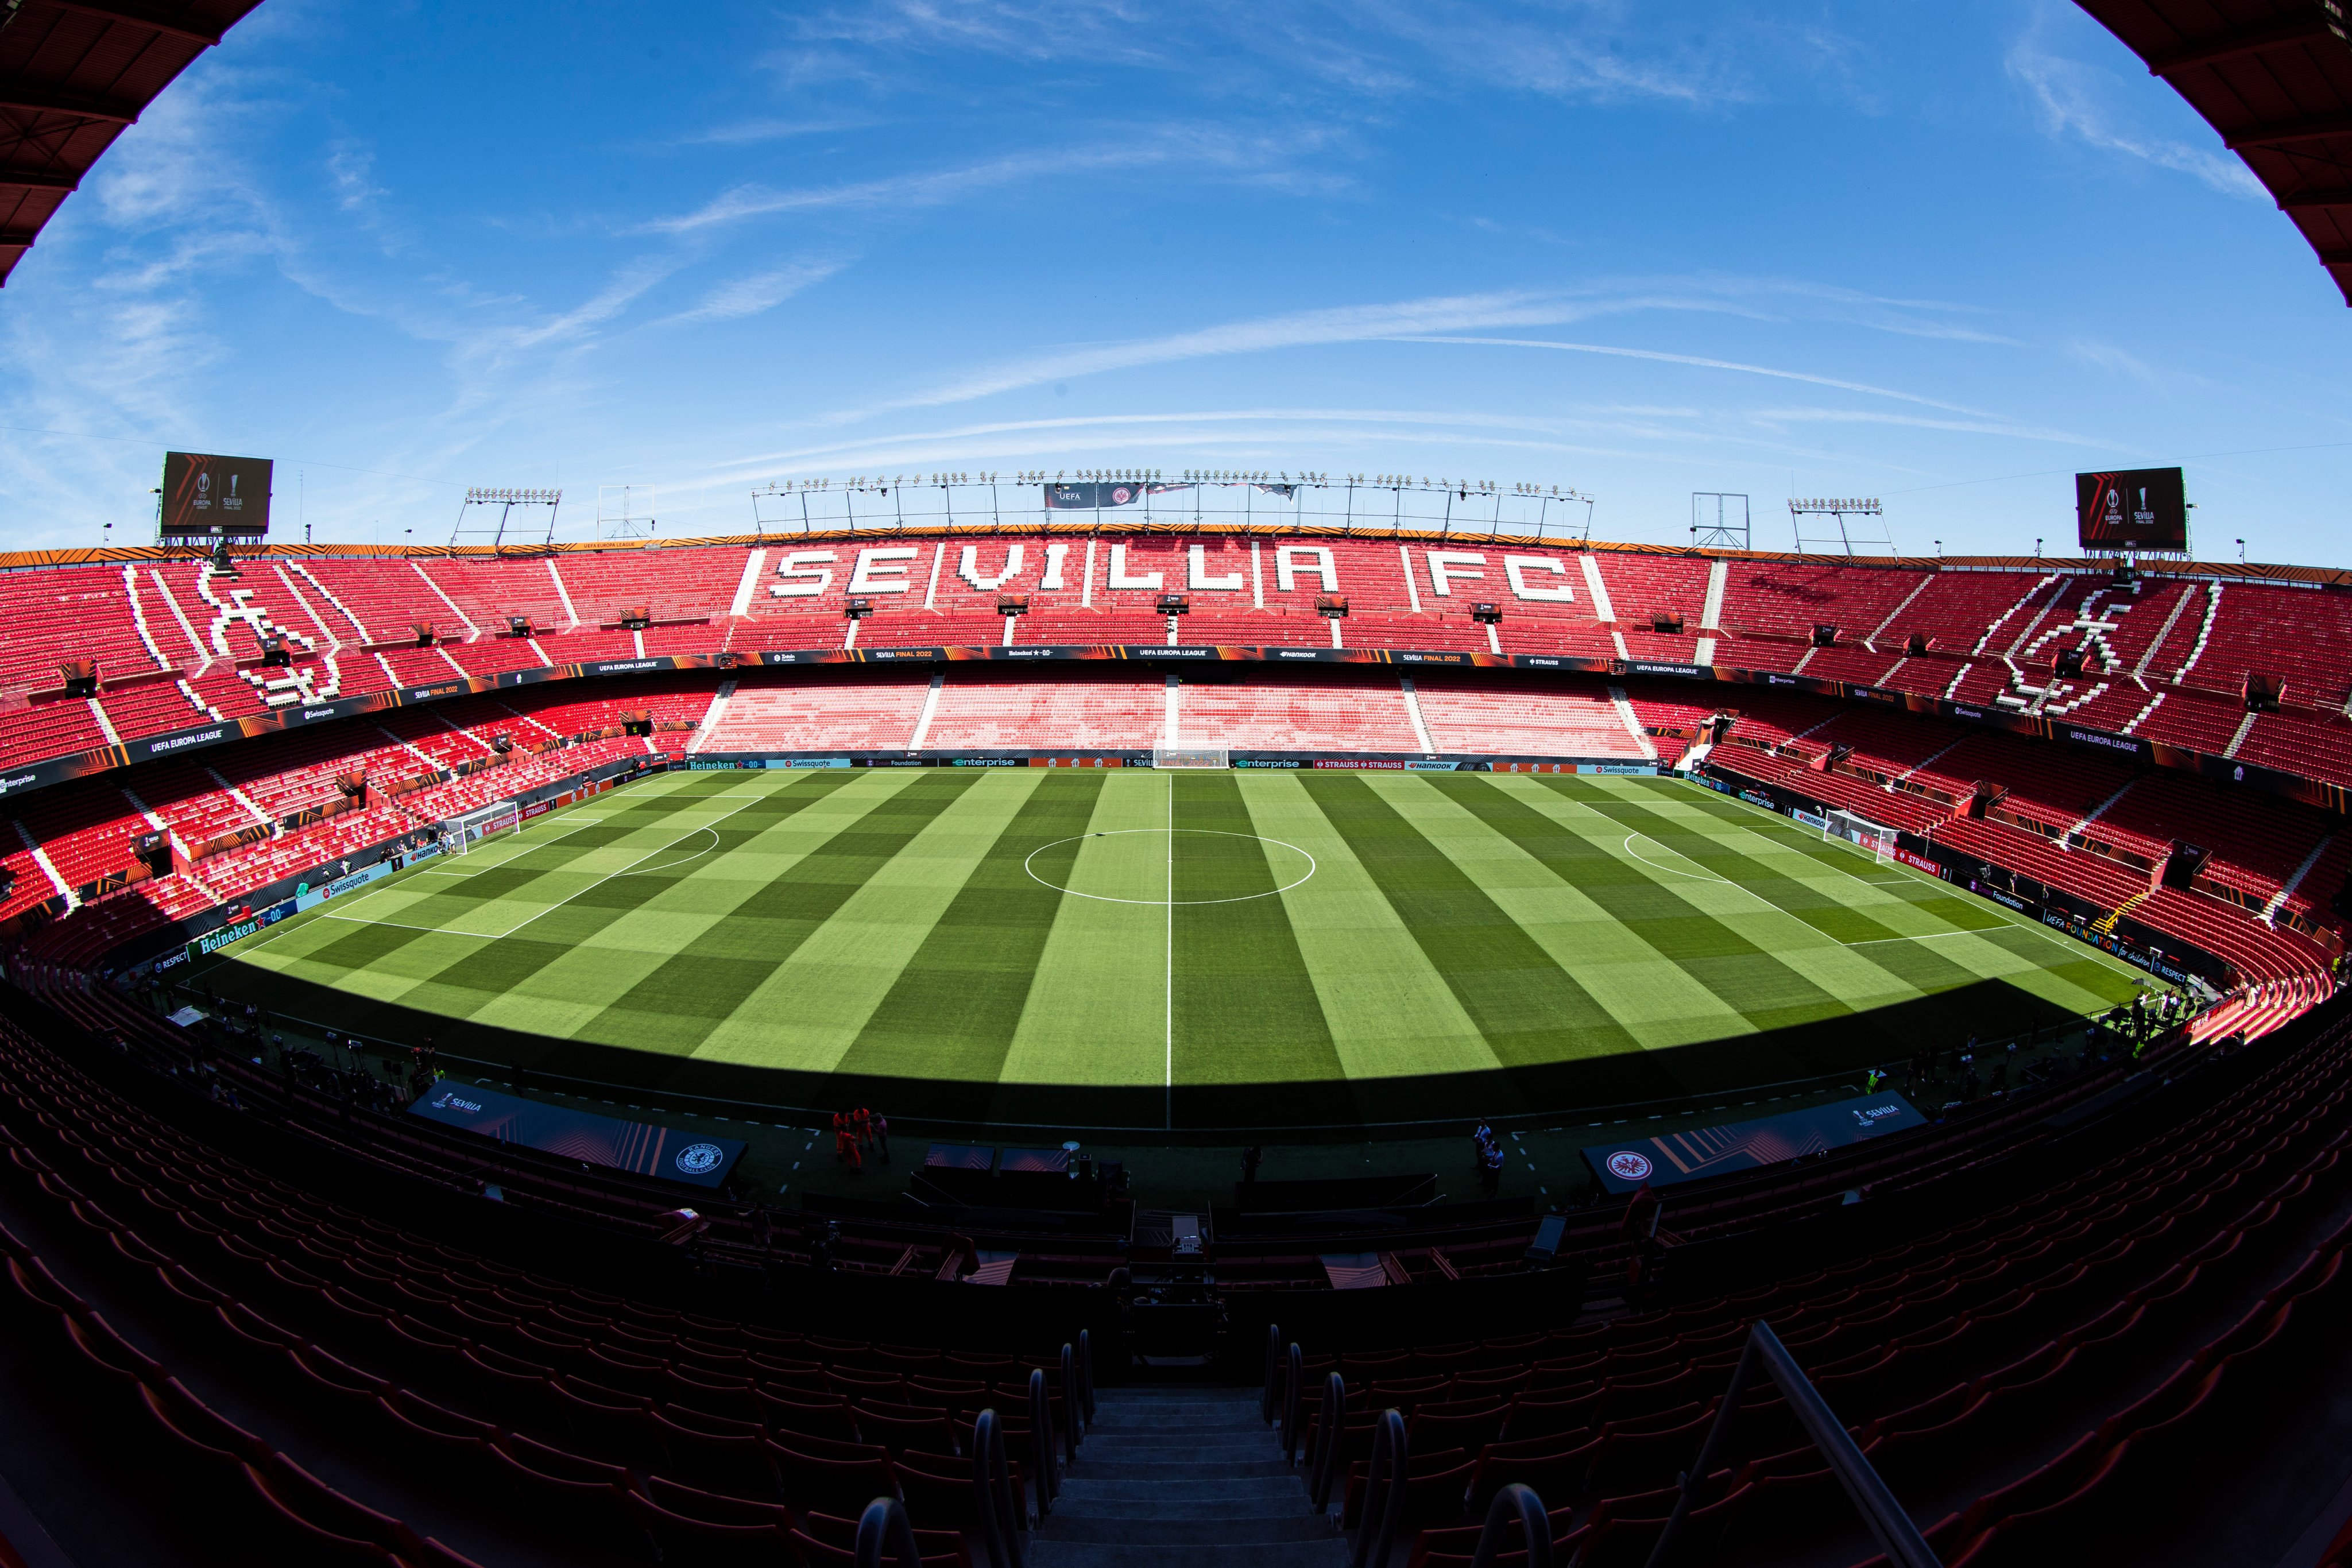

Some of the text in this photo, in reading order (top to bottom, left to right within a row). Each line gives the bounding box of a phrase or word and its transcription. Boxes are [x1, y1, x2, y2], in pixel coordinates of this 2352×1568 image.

[769, 544, 1575, 602] SEVILLA FC
[431, 688, 445, 696] FINAL
[1868, 691, 1881, 699] FINAL
[310, 708, 334, 718] Swissquote
[1959, 708, 1981, 718] Swissquote
[151, 730, 222, 753] UEFA EUROPA LEAGUE
[2071, 731, 2137, 753] UEFA EUROPA LEAGUE
[690, 760, 735, 769] Heineken
[954, 758, 1015, 768] enterprise
[1239, 760, 1299, 769] enterprise
[1603, 766, 1639, 775] Swissquote
[636, 768, 652, 778] Foundation
[1684, 771, 1710, 787] Heineken
[1740, 791, 1774, 810] enterprise
[525, 804, 547, 817] STRAUSS
[493, 815, 516, 830] STRAUSS
[1871, 842, 1896, 857] STRAUSS
[1908, 855, 1936, 873] STRAUSS
[330, 874, 369, 895] Swissquote
[1993, 891, 2023, 910] Foundation
[201, 920, 257, 955] Heineken
[2047, 915, 2065, 928] UEFA
[2117, 946, 2126, 958] for
[2127, 950, 2150, 967] children
[163, 951, 187, 969] RESPECT
[2161, 965, 2185, 982] RESPECT
[688, 1144, 721, 1155] RANGERS
[679, 1155, 716, 1171] FOOTBALL CLUB
